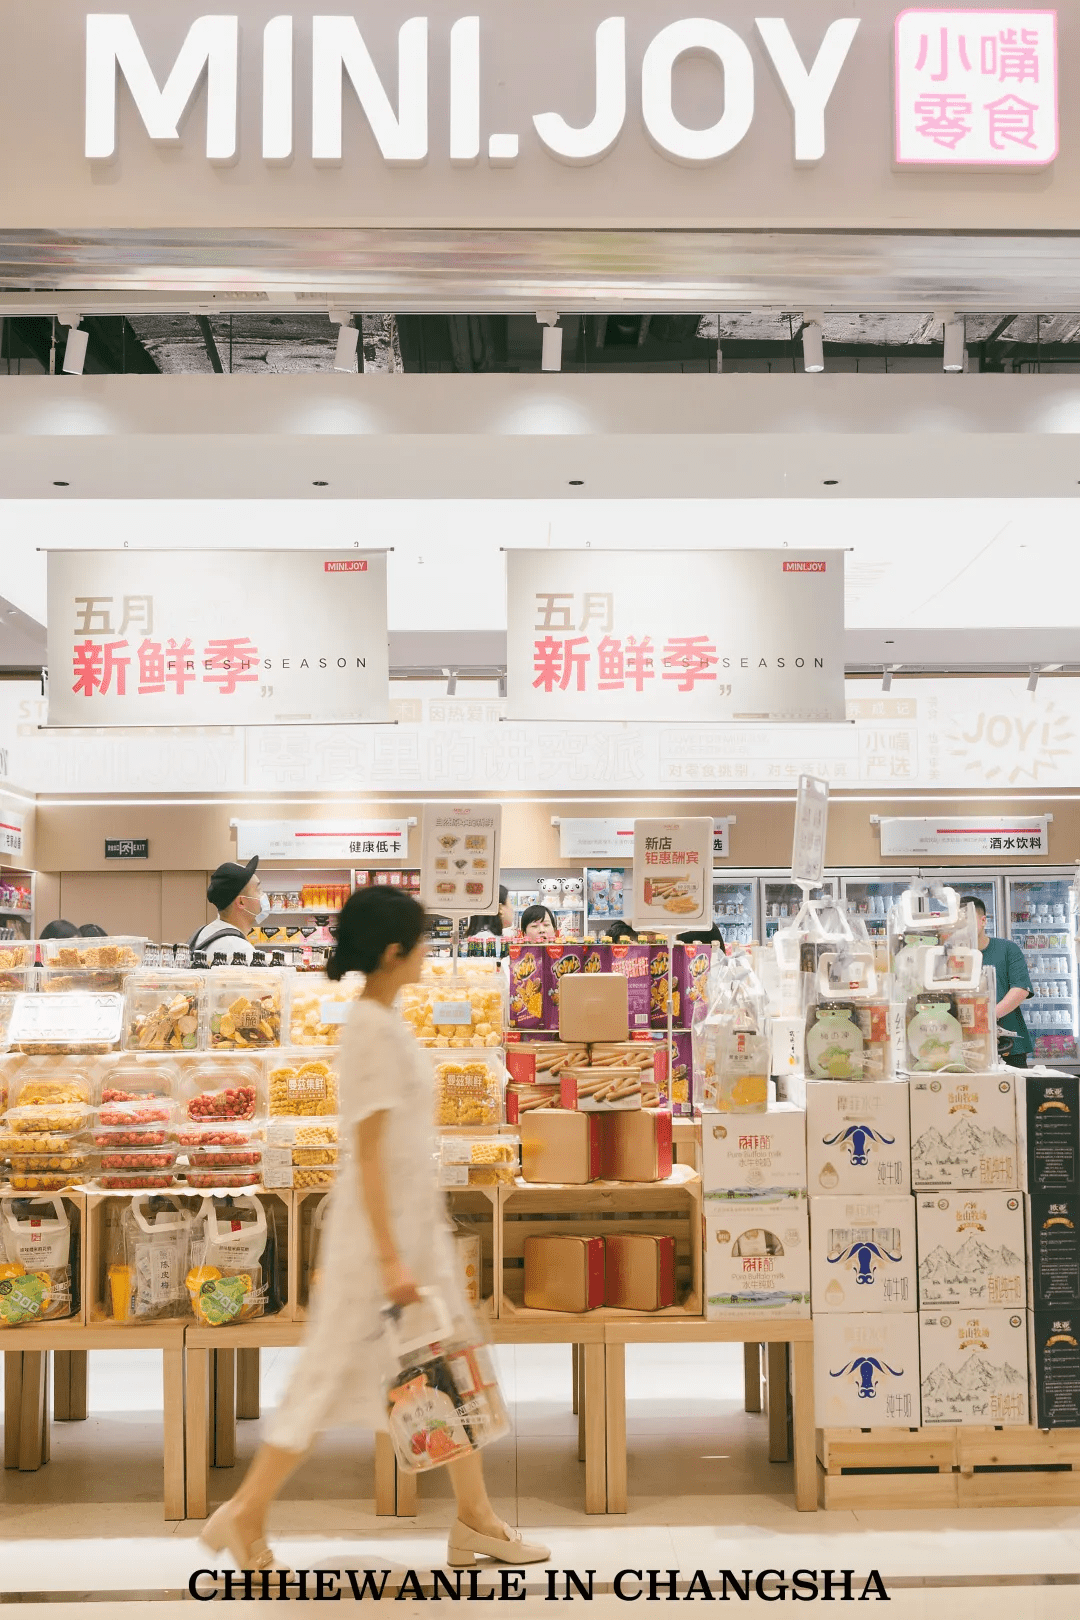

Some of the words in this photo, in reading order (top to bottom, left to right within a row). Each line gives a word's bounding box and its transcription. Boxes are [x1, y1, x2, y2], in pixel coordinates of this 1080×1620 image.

[916, 27, 1041, 83] 小嘴
[84, 14, 861, 161] MINI.JOY
[914, 93, 1041, 151] 零食
[327, 561, 365, 571] MINI.JOY
[786, 562, 824, 572] MINI.JOY
[74, 595, 153, 636] 五月
[534, 592, 614, 632] 五月
[72, 637, 260, 697] 新鲜季
[532, 635, 720, 692] 新鲜季
[349, 840, 402, 853] 健康低卡
[645, 836, 672, 850] 新店
[989, 836, 1042, 850] 酒水饮料
